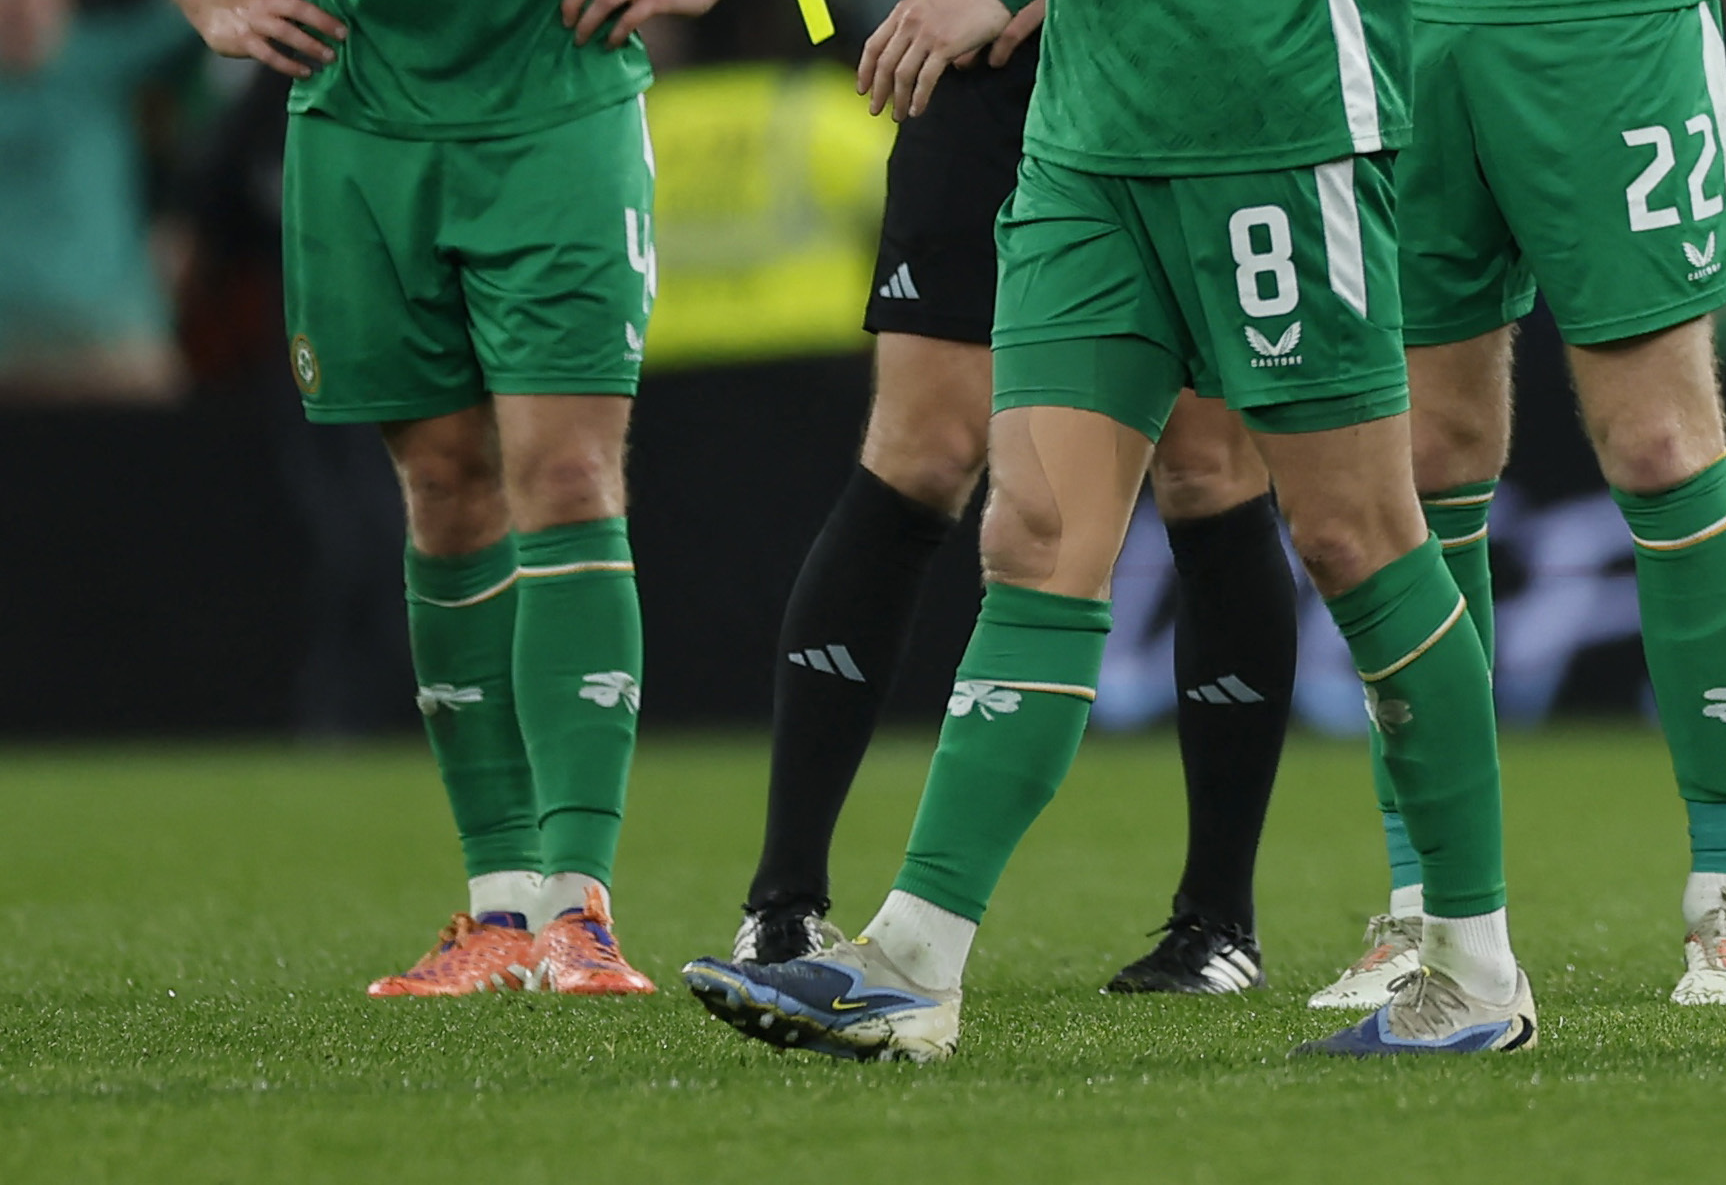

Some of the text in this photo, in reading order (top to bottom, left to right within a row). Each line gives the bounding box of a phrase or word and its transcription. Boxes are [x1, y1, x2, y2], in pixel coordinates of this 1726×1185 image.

[1621, 113, 1724, 232] 22
[1229, 204, 1299, 317] 8
[1250, 355, 1303, 368] CASTORE
